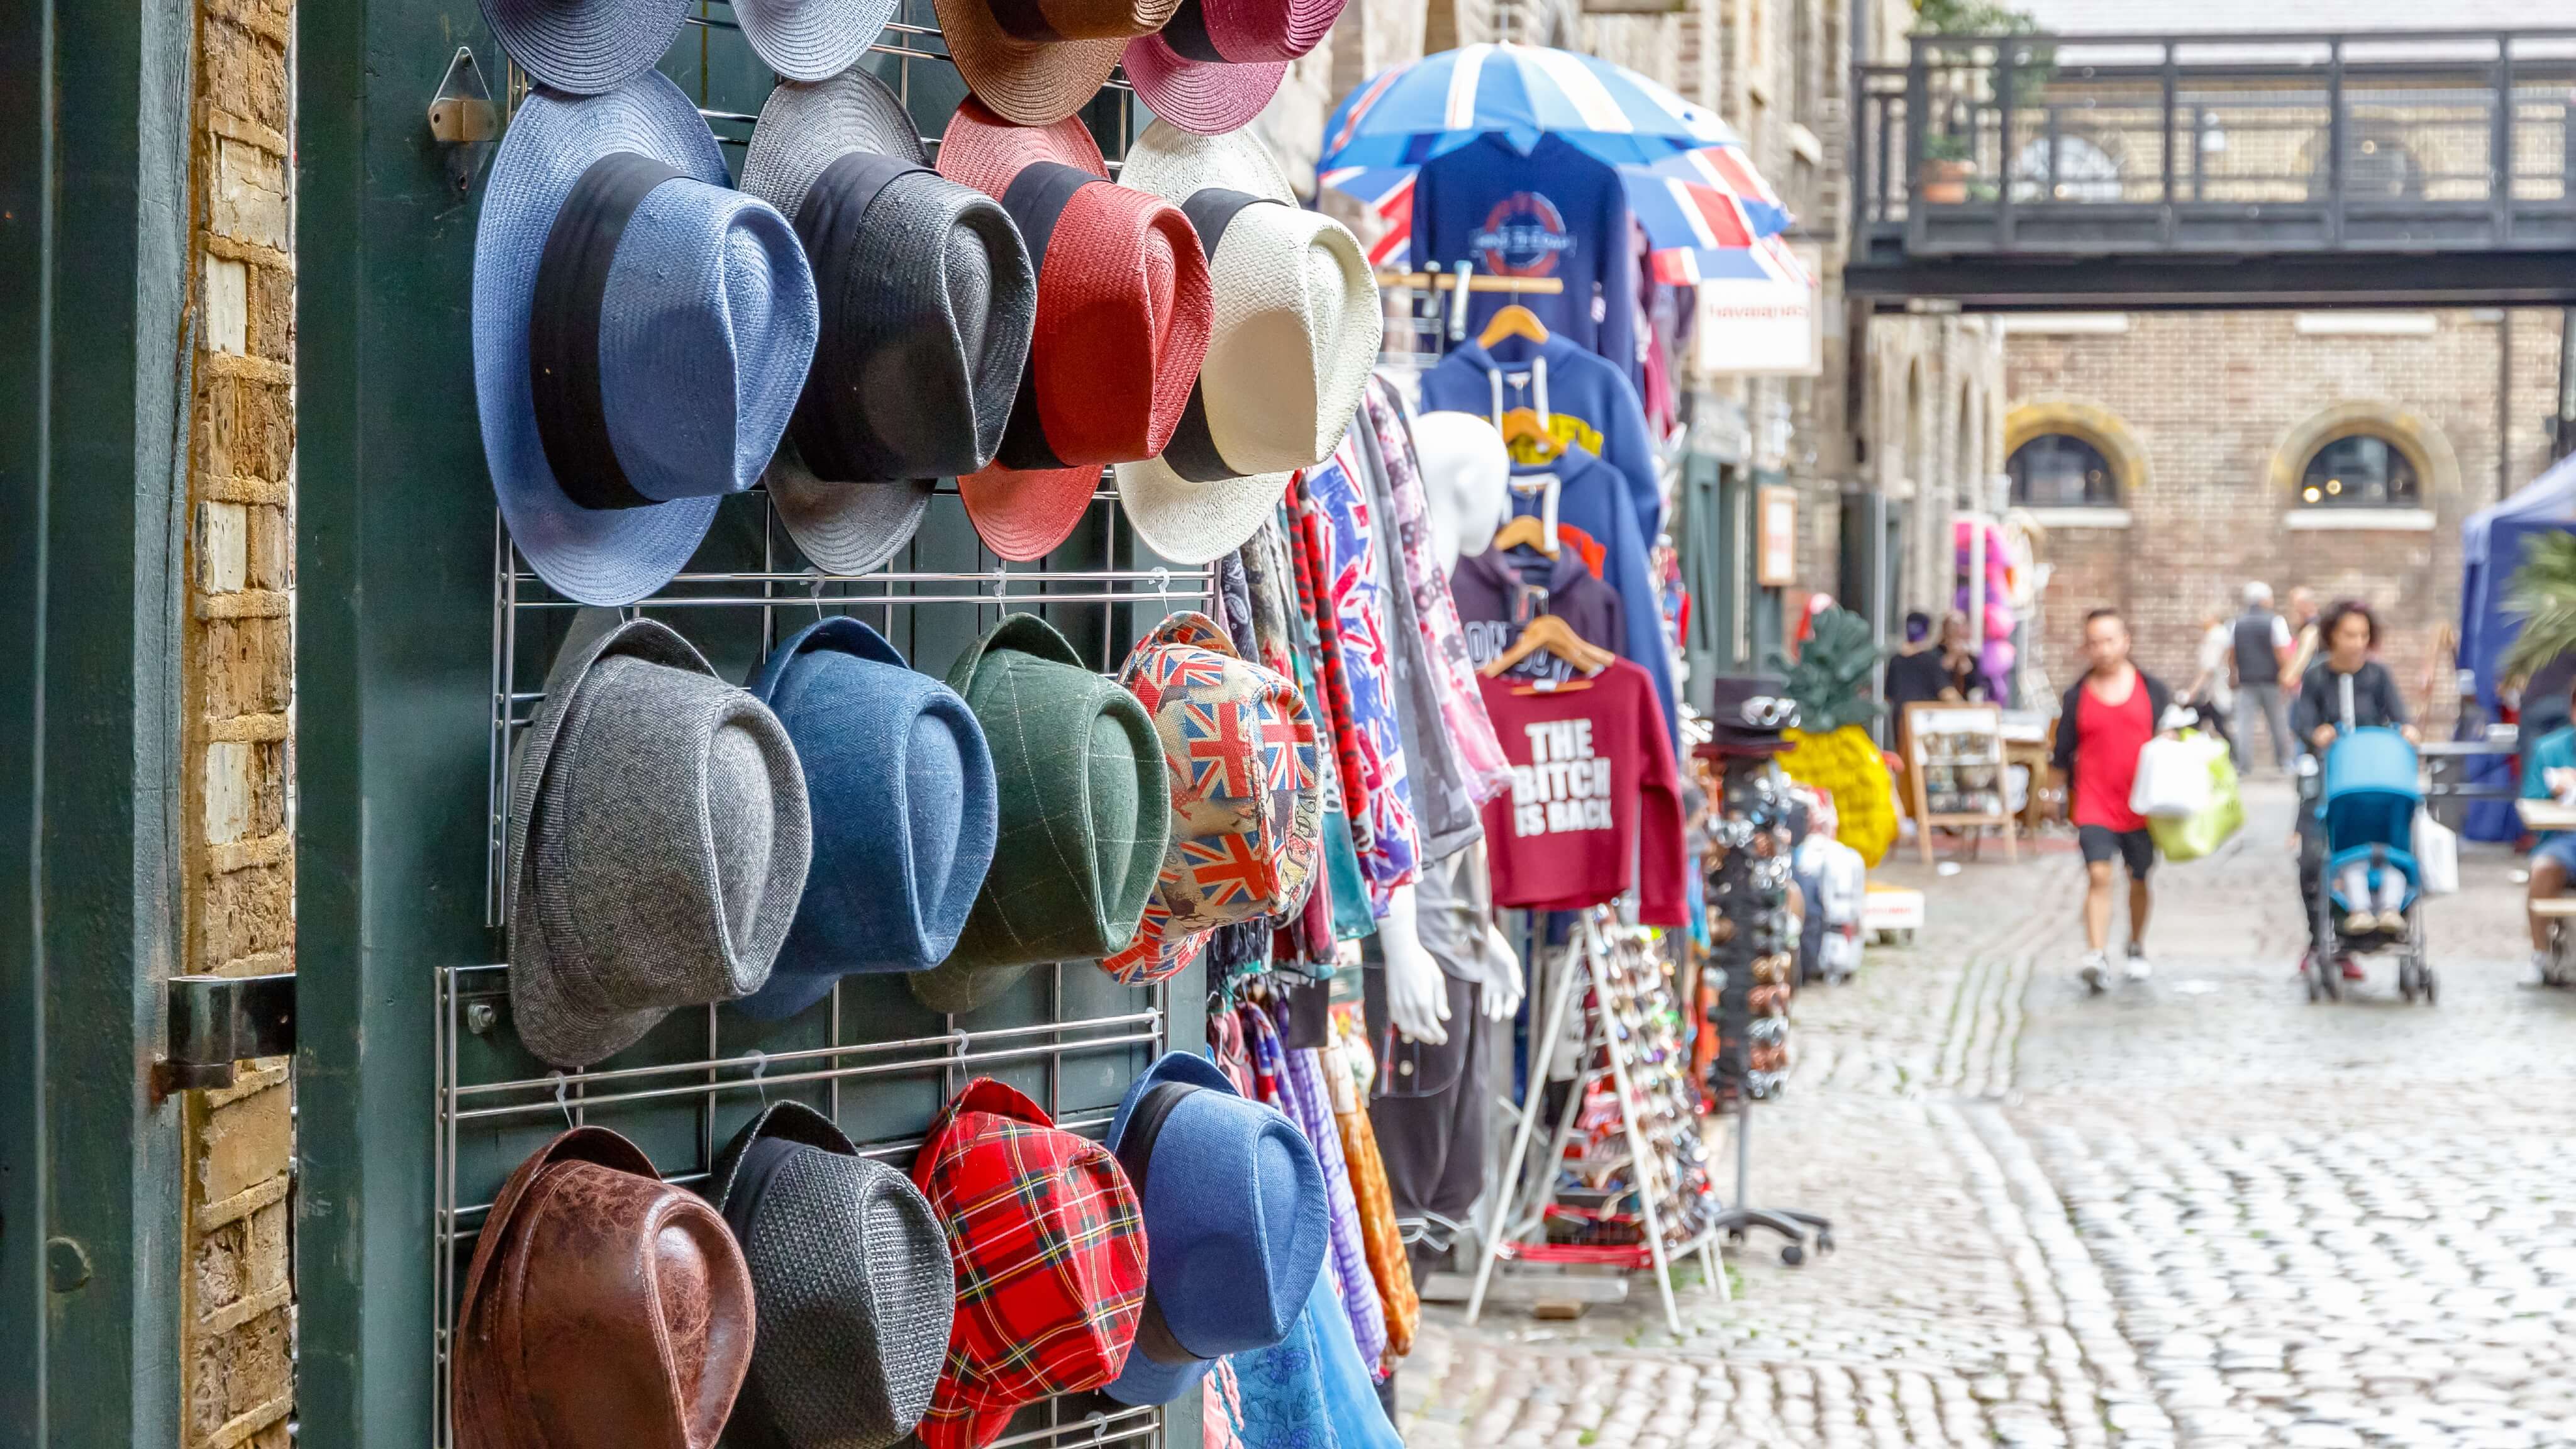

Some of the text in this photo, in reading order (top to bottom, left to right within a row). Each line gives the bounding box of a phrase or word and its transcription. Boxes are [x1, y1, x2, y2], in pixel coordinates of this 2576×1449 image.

[1524, 718, 1595, 764] THE
[1512, 757, 1611, 806] BITCH
[1514, 797, 1613, 837] IS BACK
